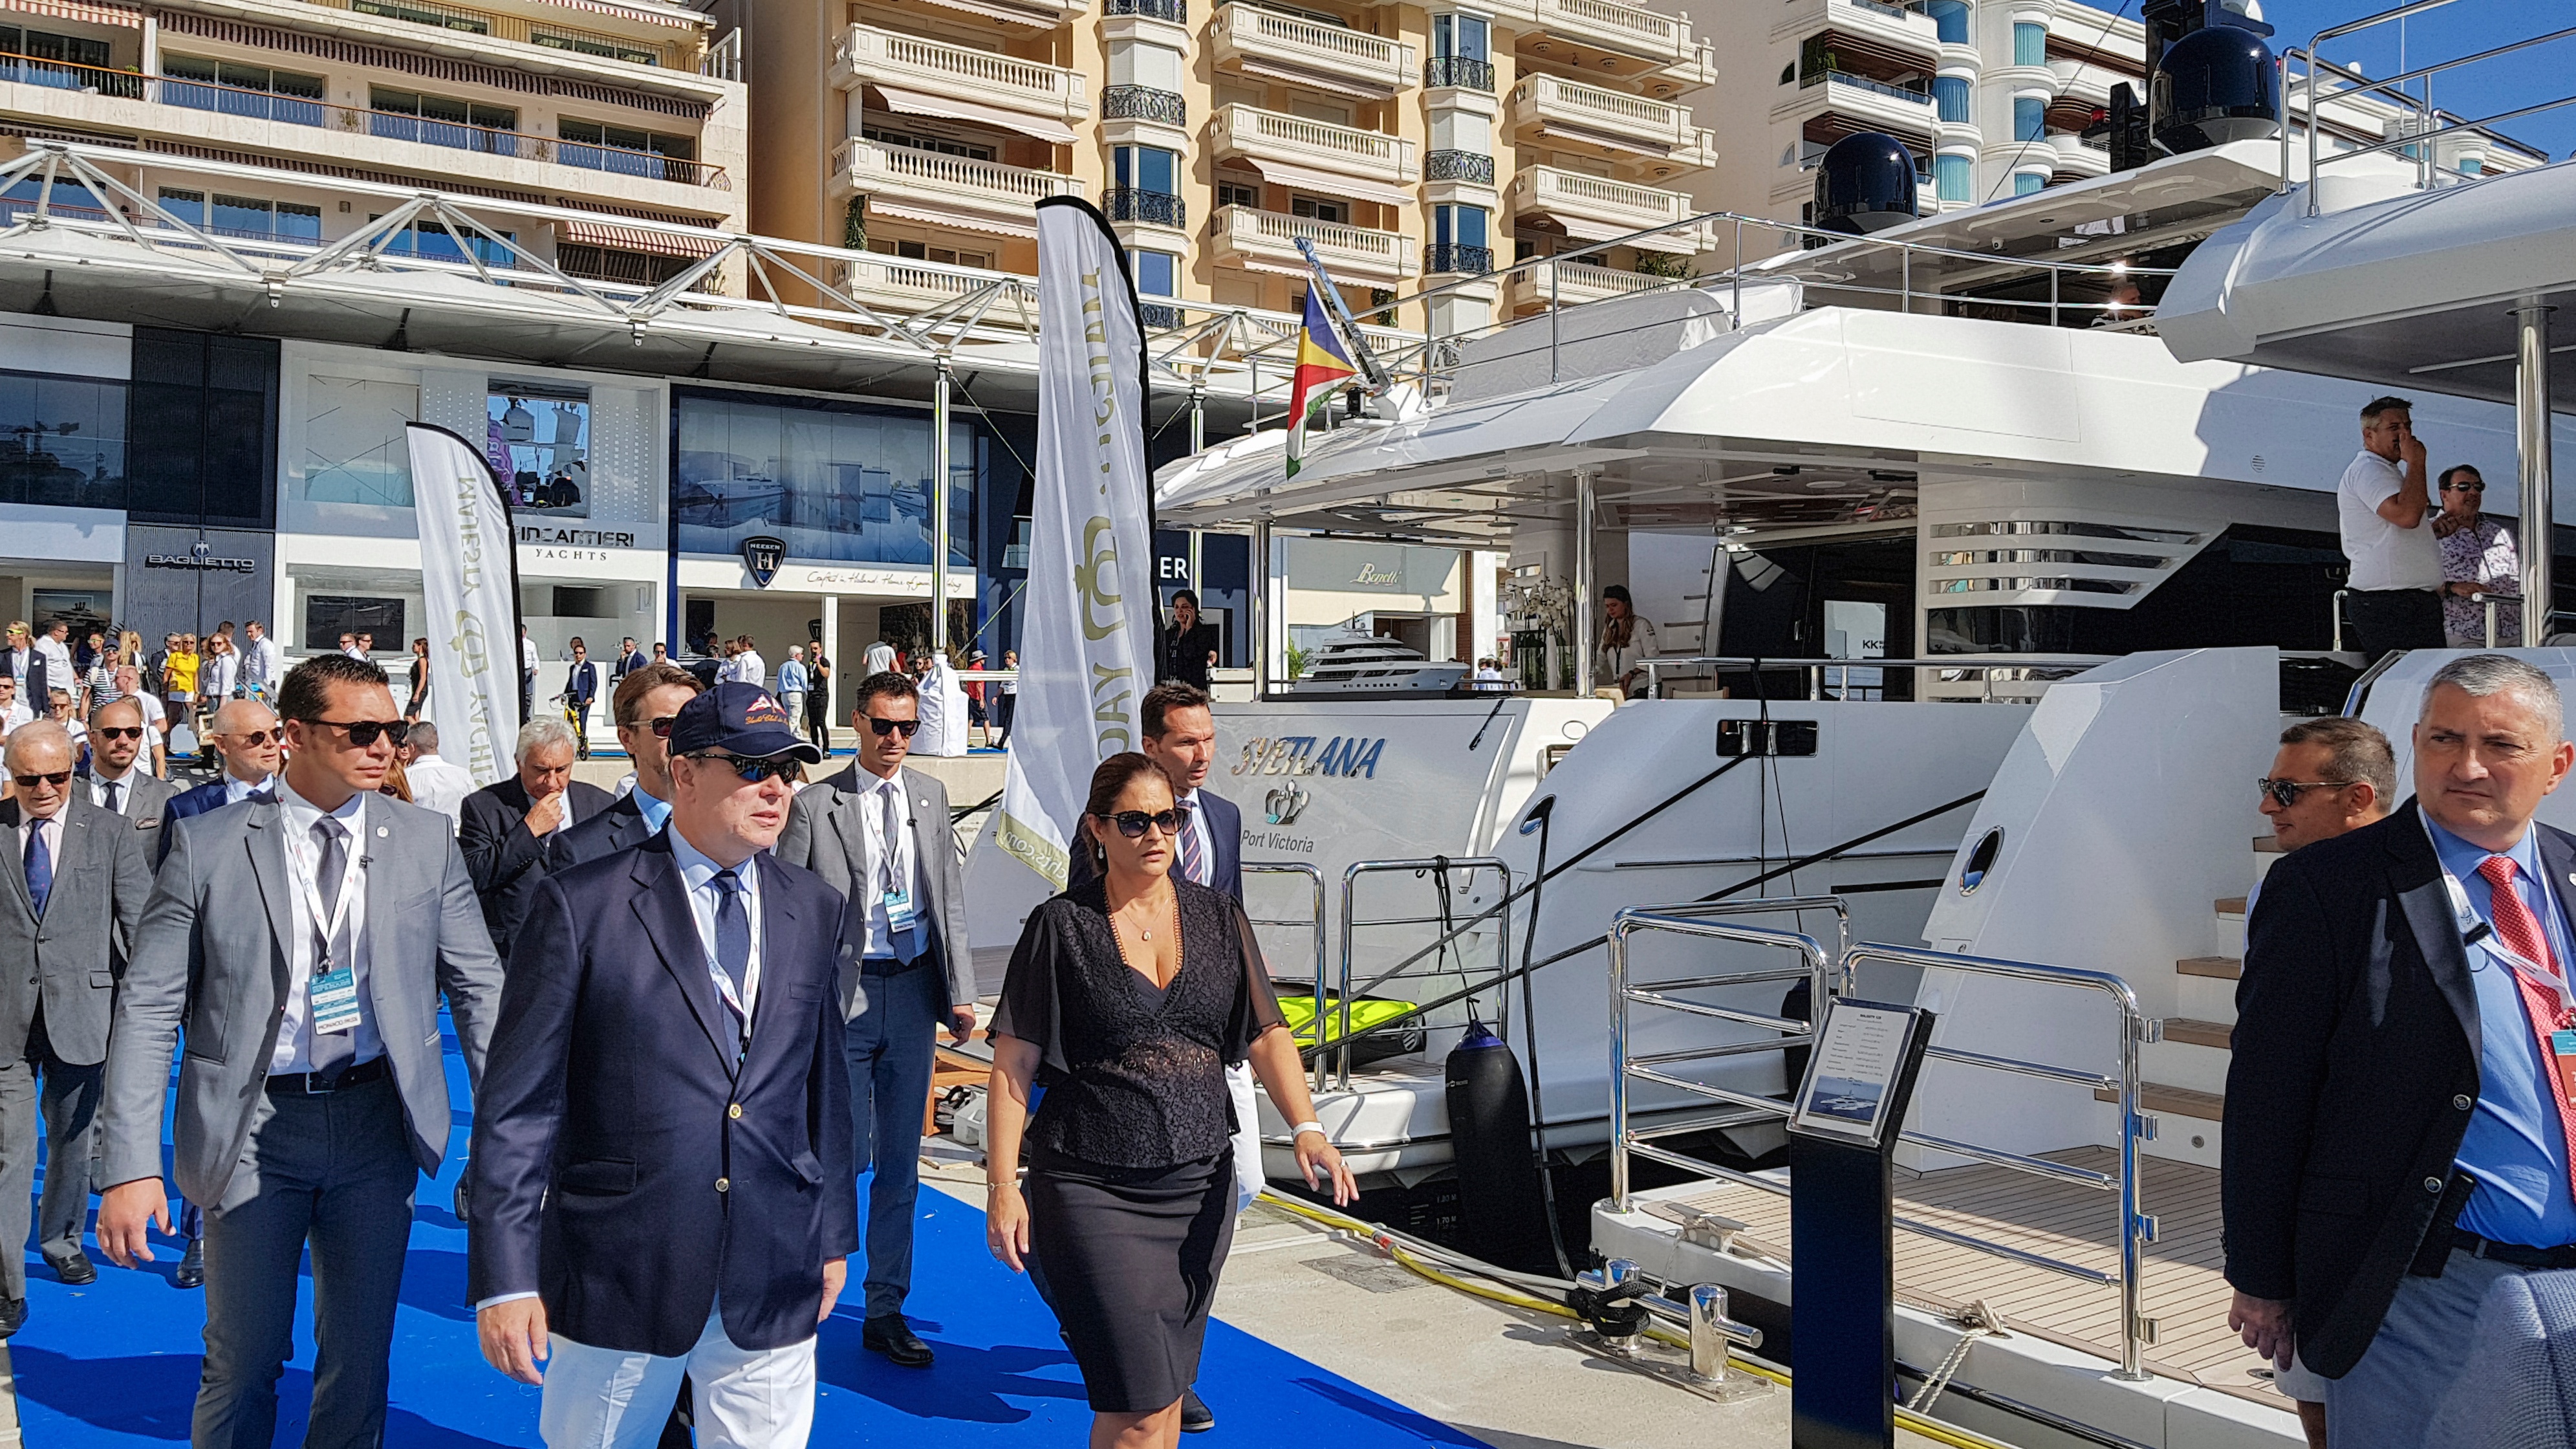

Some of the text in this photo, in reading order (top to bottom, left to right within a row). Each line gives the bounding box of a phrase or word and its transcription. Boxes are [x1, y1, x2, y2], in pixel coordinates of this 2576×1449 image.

[147, 554, 255, 568] BAGLIETTO
[535, 549, 607, 561] YACHTS
[755, 551, 776, 571] H
[1348, 562, 1403, 586] Benetti
[1231, 736, 1387, 779] SVETLANA
[1241, 829, 1314, 853] Port Victoria
